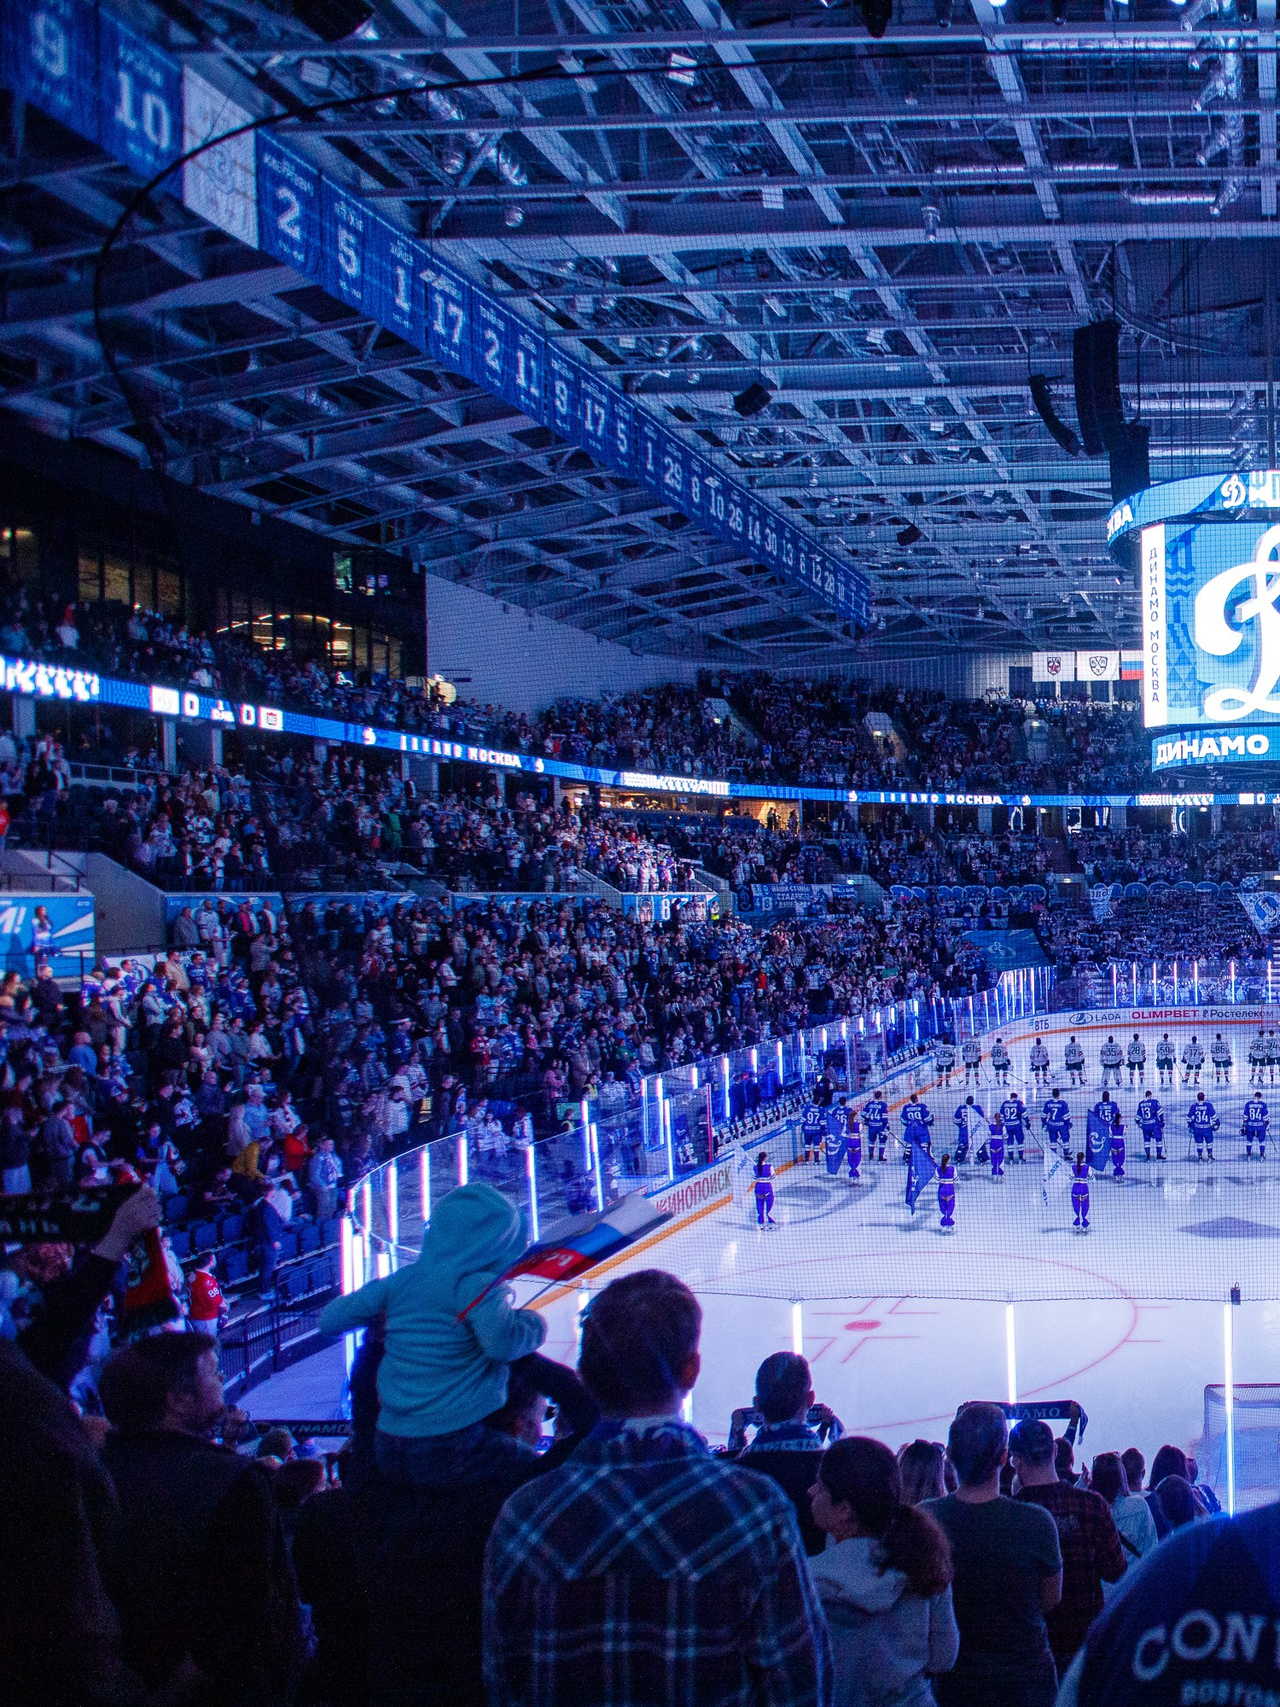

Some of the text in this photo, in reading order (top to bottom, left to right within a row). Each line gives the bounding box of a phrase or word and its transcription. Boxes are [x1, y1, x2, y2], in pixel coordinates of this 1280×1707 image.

[115, 70, 171, 150] 10
[276, 186, 301, 240] 2
[338, 225, 360, 278] 5
[395, 266, 411, 313] 1
[433, 293, 464, 345] 17
[485, 328, 502, 373] 2
[585, 398, 606, 438] 17
[616, 418, 628, 453] 5
[709, 488, 724, 520] 10
[748, 515, 761, 545] 14
[1149, 548, 1160, 702] ДИНАМО МОСКВА
[1156, 734, 1270, 765] ДИНАМО
[1034, 1019, 1050, 1031] ВТБ
[1096, 1013, 1121, 1022] LADA
[1131, 1009, 1199, 1020] OLIMPBET
[806, 1112, 820, 1124] 97
[867, 1109, 881, 1120] 44
[1004, 1108, 1018, 1120] 92
[1051, 1108, 1058, 1120] 7
[1141, 1107, 1151, 1119] 13
[1195, 1110, 1209, 1122] 34
[1249, 1108, 1262, 1121] 84
